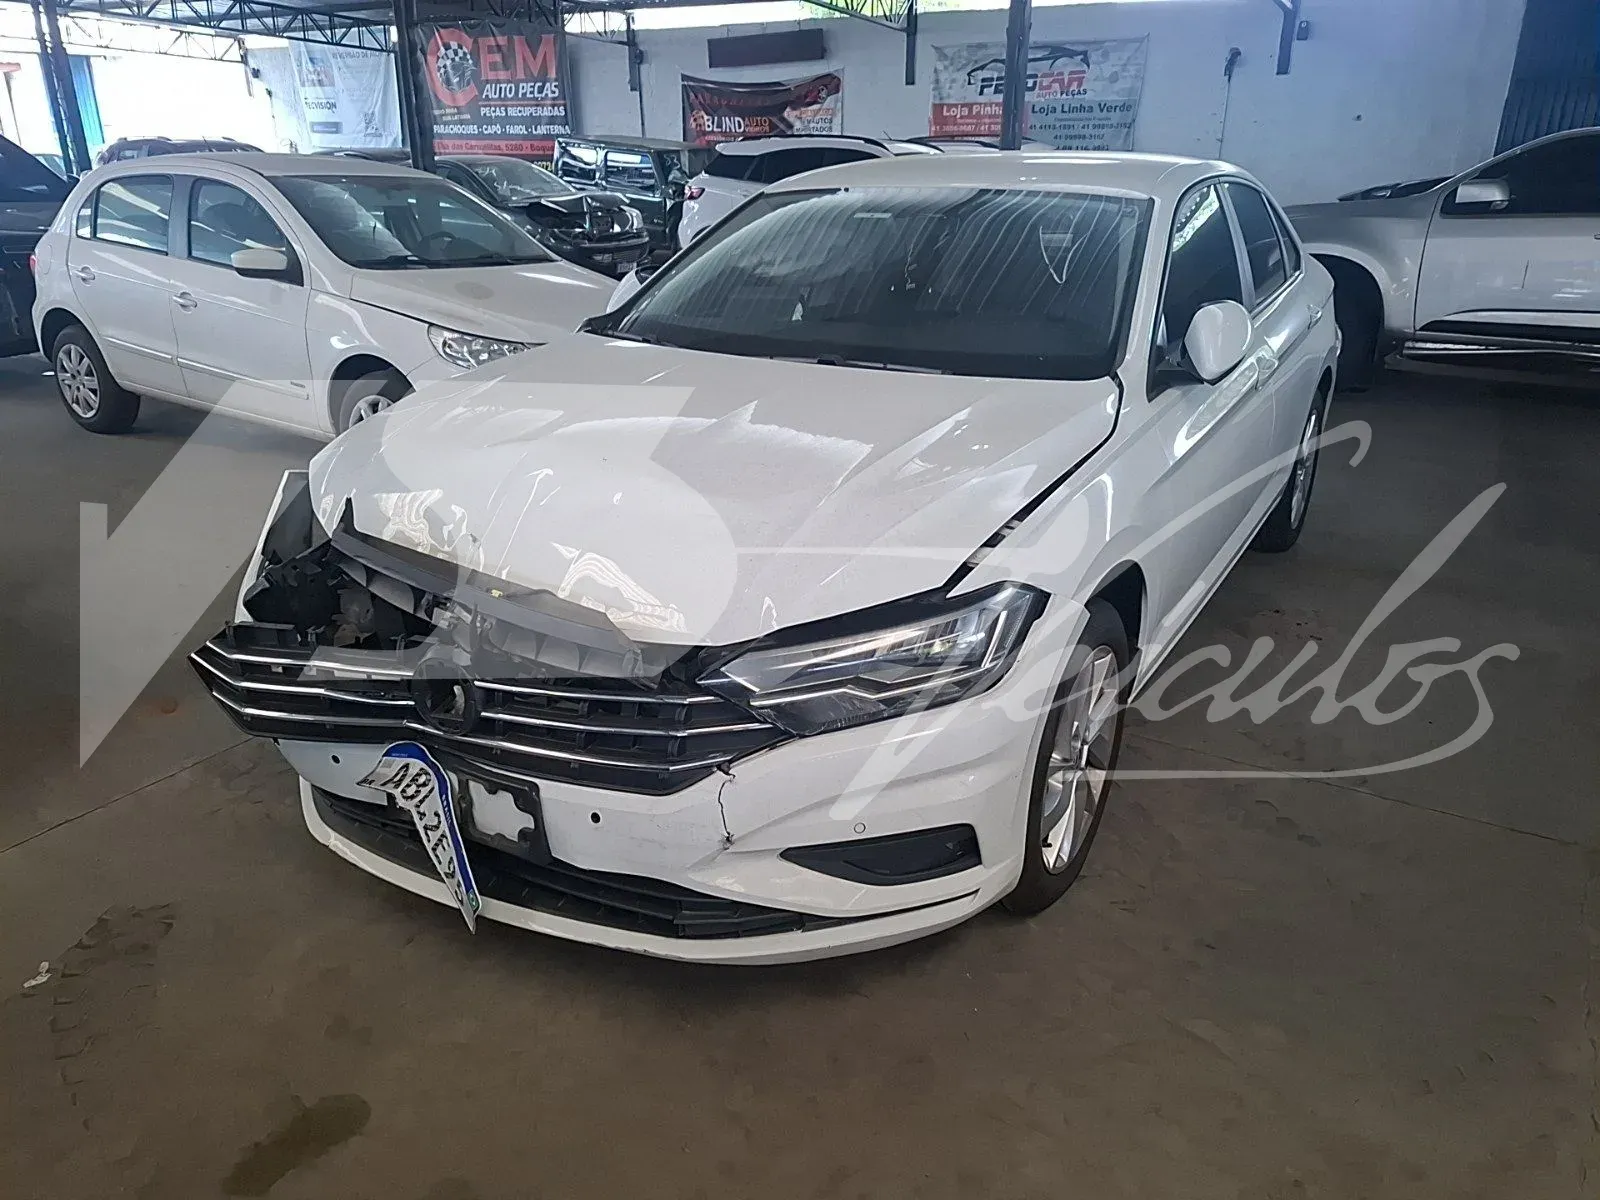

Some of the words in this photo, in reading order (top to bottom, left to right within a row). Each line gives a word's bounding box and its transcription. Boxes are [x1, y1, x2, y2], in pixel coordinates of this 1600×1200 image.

[482, 83, 515, 98] AUTO
[519, 82, 559, 101] PEÇAS
[1061, 88, 1088, 98] PEÇAS
[480, 106, 506, 119] PEÇAS
[507, 106, 566, 117] RECUPERADAS
[943, 104, 969, 118] Loja
[1031, 104, 1057, 116] Loja
[1061, 103, 1094, 114] Linha
[1098, 102, 1133, 113] Verde
[704, 116, 745, 133] BLIND
[745, 116, 769, 126] AUTO
[433, 124, 479, 135] PARACHOQUES
[482, 123, 502, 135] CAPÔ
[506, 125, 528, 134] FAROL
[532, 125, 571, 134] LANTERNA
